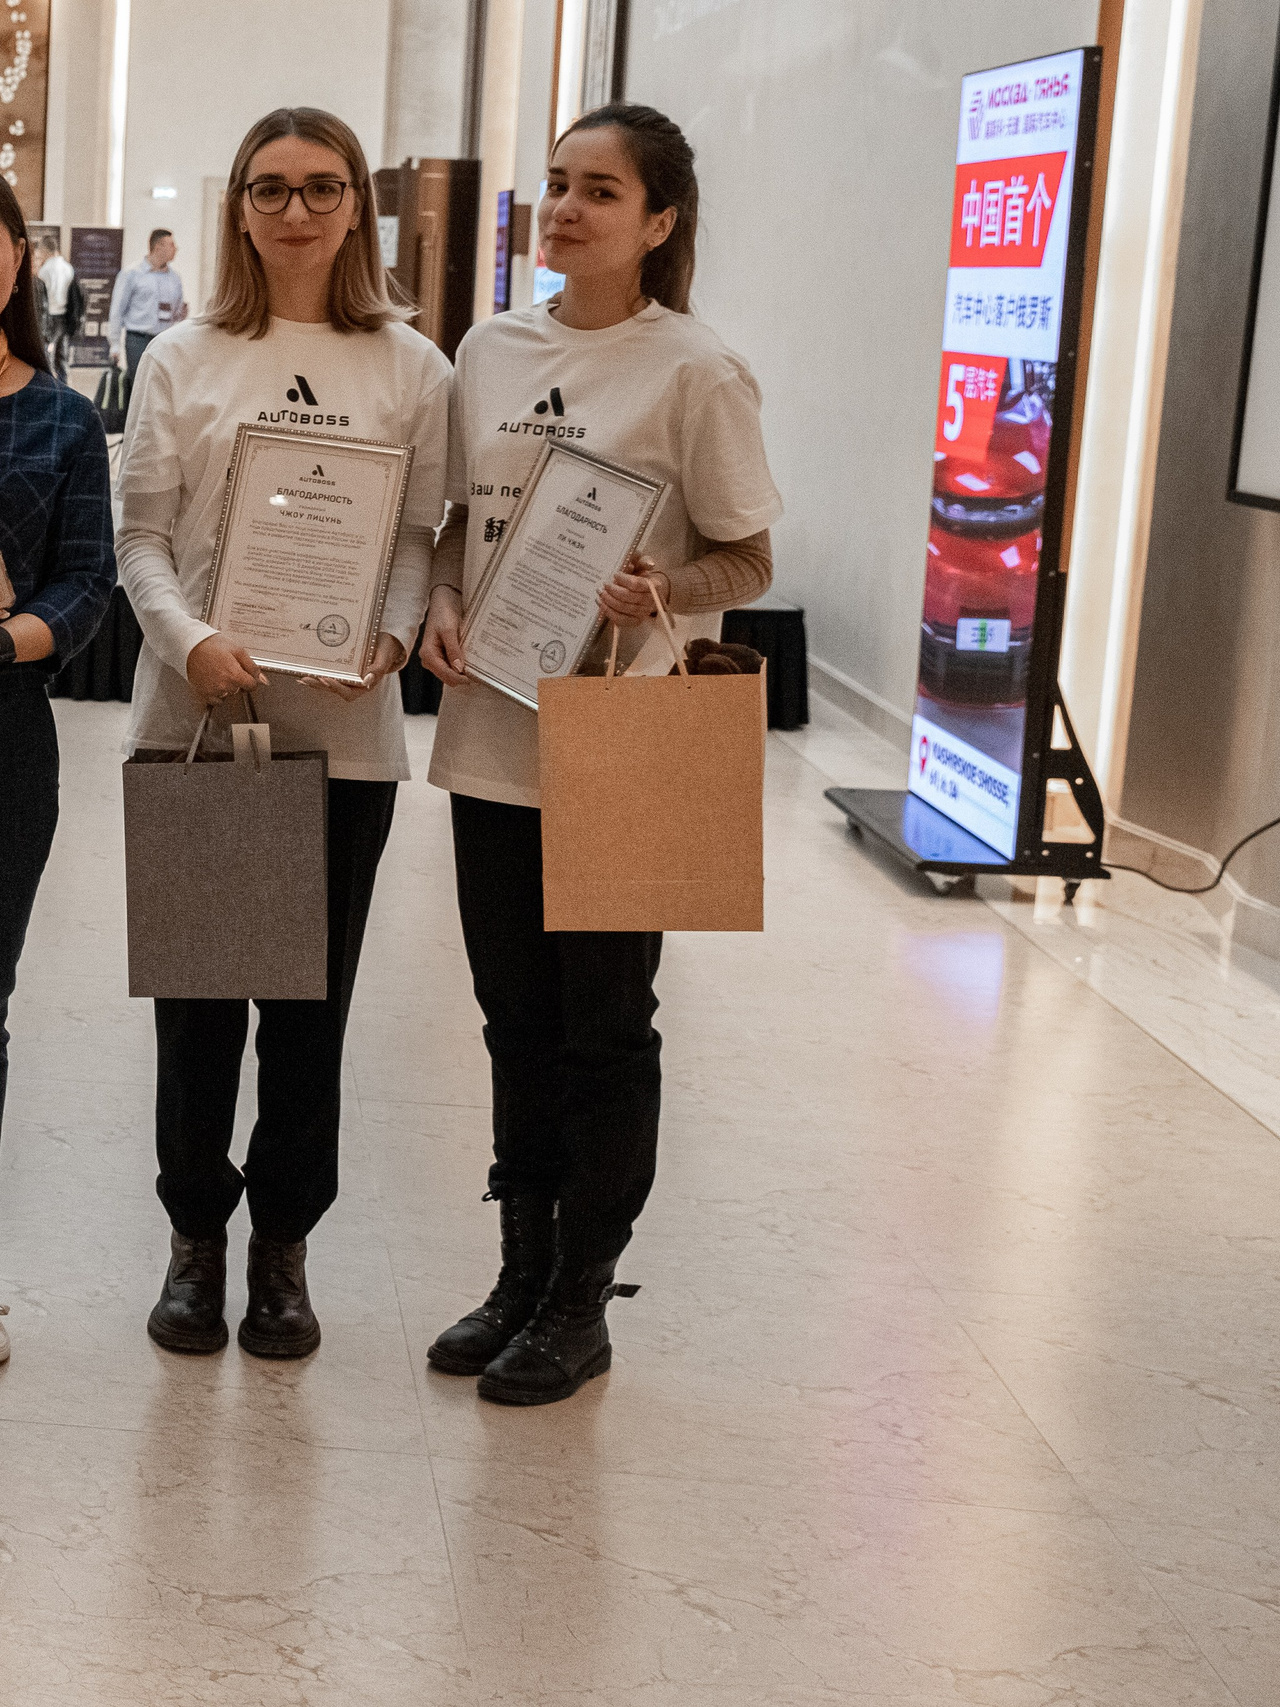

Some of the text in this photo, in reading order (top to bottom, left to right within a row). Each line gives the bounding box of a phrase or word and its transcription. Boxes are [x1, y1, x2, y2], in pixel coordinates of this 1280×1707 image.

[961, 171, 1053, 248] 中国首个
[943, 363, 964, 442] 5
[257, 409, 350, 427] AUTOBOSS
[299, 477, 336, 486] AUTOBOSS
[277, 488, 353, 505] БЛАГОДАРНОСТЬ
[279, 510, 305, 519] ЧЖОУ
[556, 505, 607, 533] БЛАГОДАРНОСТЬ
